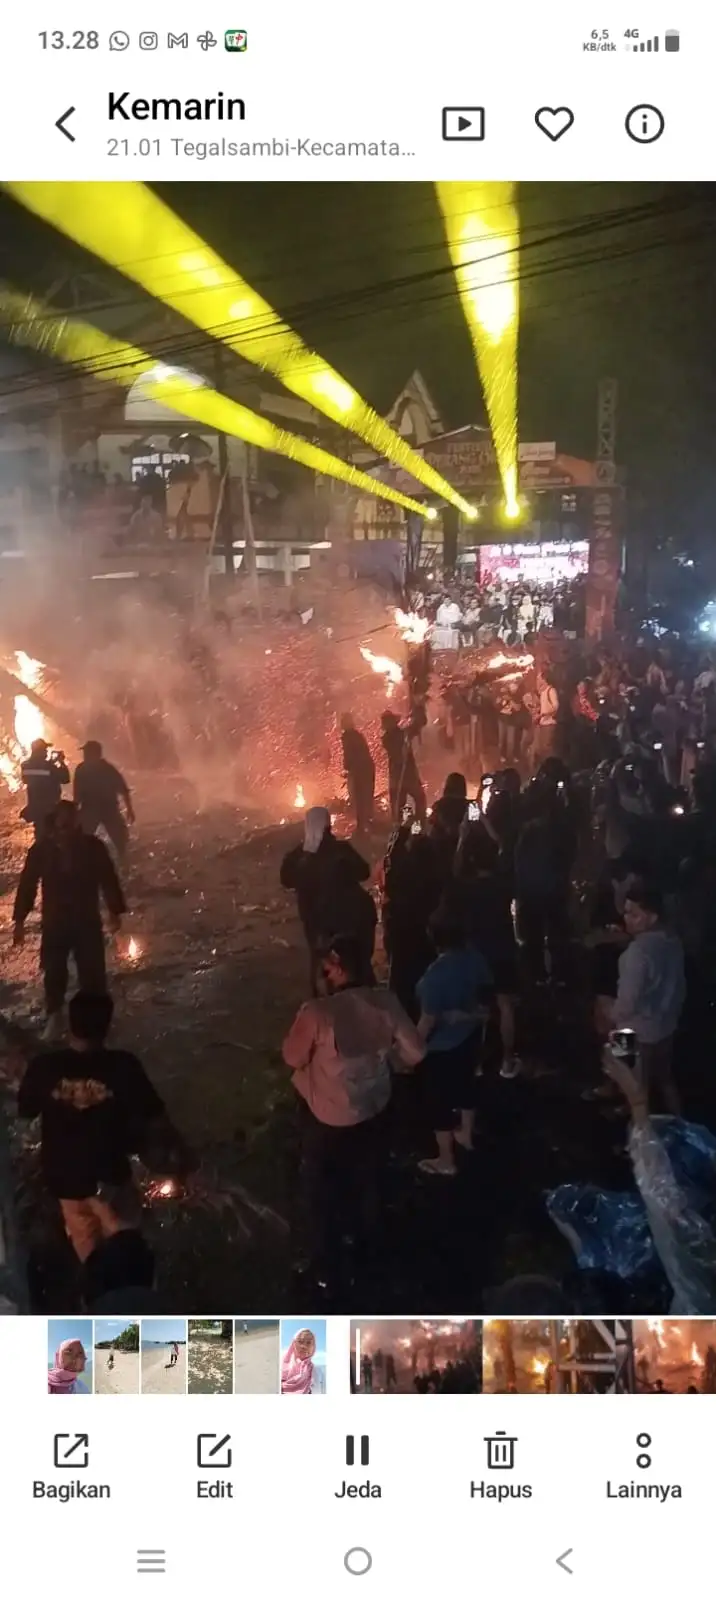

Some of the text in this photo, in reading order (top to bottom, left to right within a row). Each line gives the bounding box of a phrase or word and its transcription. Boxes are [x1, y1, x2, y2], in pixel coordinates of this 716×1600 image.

[38, 30, 100, 50] 13.28
[590, 28, 610, 42] 6,5
[623, 28, 640, 39] 4G
[582, 42, 617, 52] KB/dtk
[107, 91, 246, 120] Kemarin
[107, 138, 161, 157] 21.01
[32, 1480, 111, 1503] Bagikan
[196, 1480, 234, 1499] Edit
[334, 1480, 382, 1499] Jeda
[470, 1480, 533, 1503] Hapus
[606, 1480, 683, 1503] Lainnya
